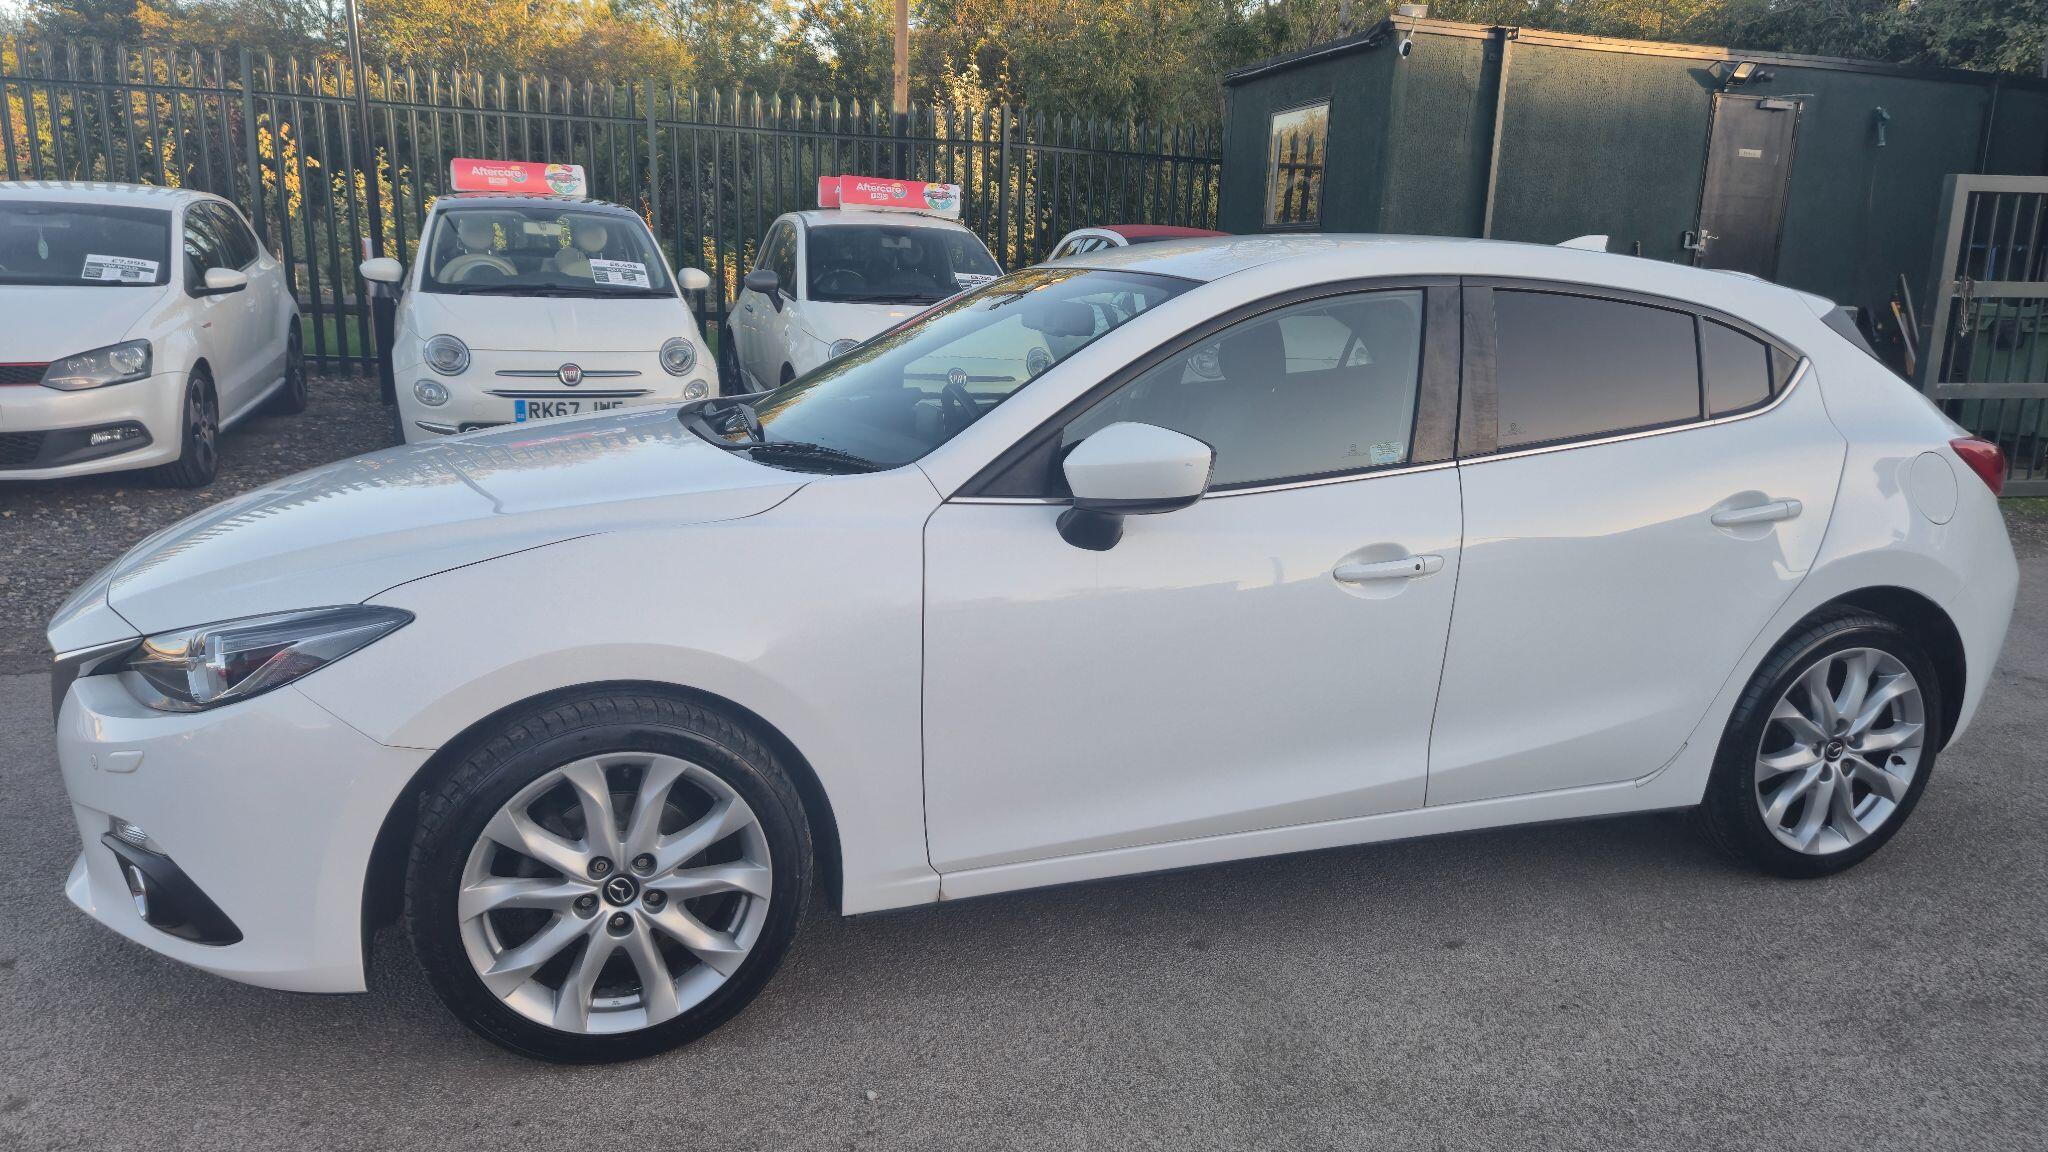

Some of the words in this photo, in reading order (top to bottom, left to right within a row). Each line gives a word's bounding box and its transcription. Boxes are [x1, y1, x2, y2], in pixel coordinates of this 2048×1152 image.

[471, 166, 521, 177] Aftercare
[856, 182, 902, 194] Aftercare
[528, 401, 580, 419] RK67
